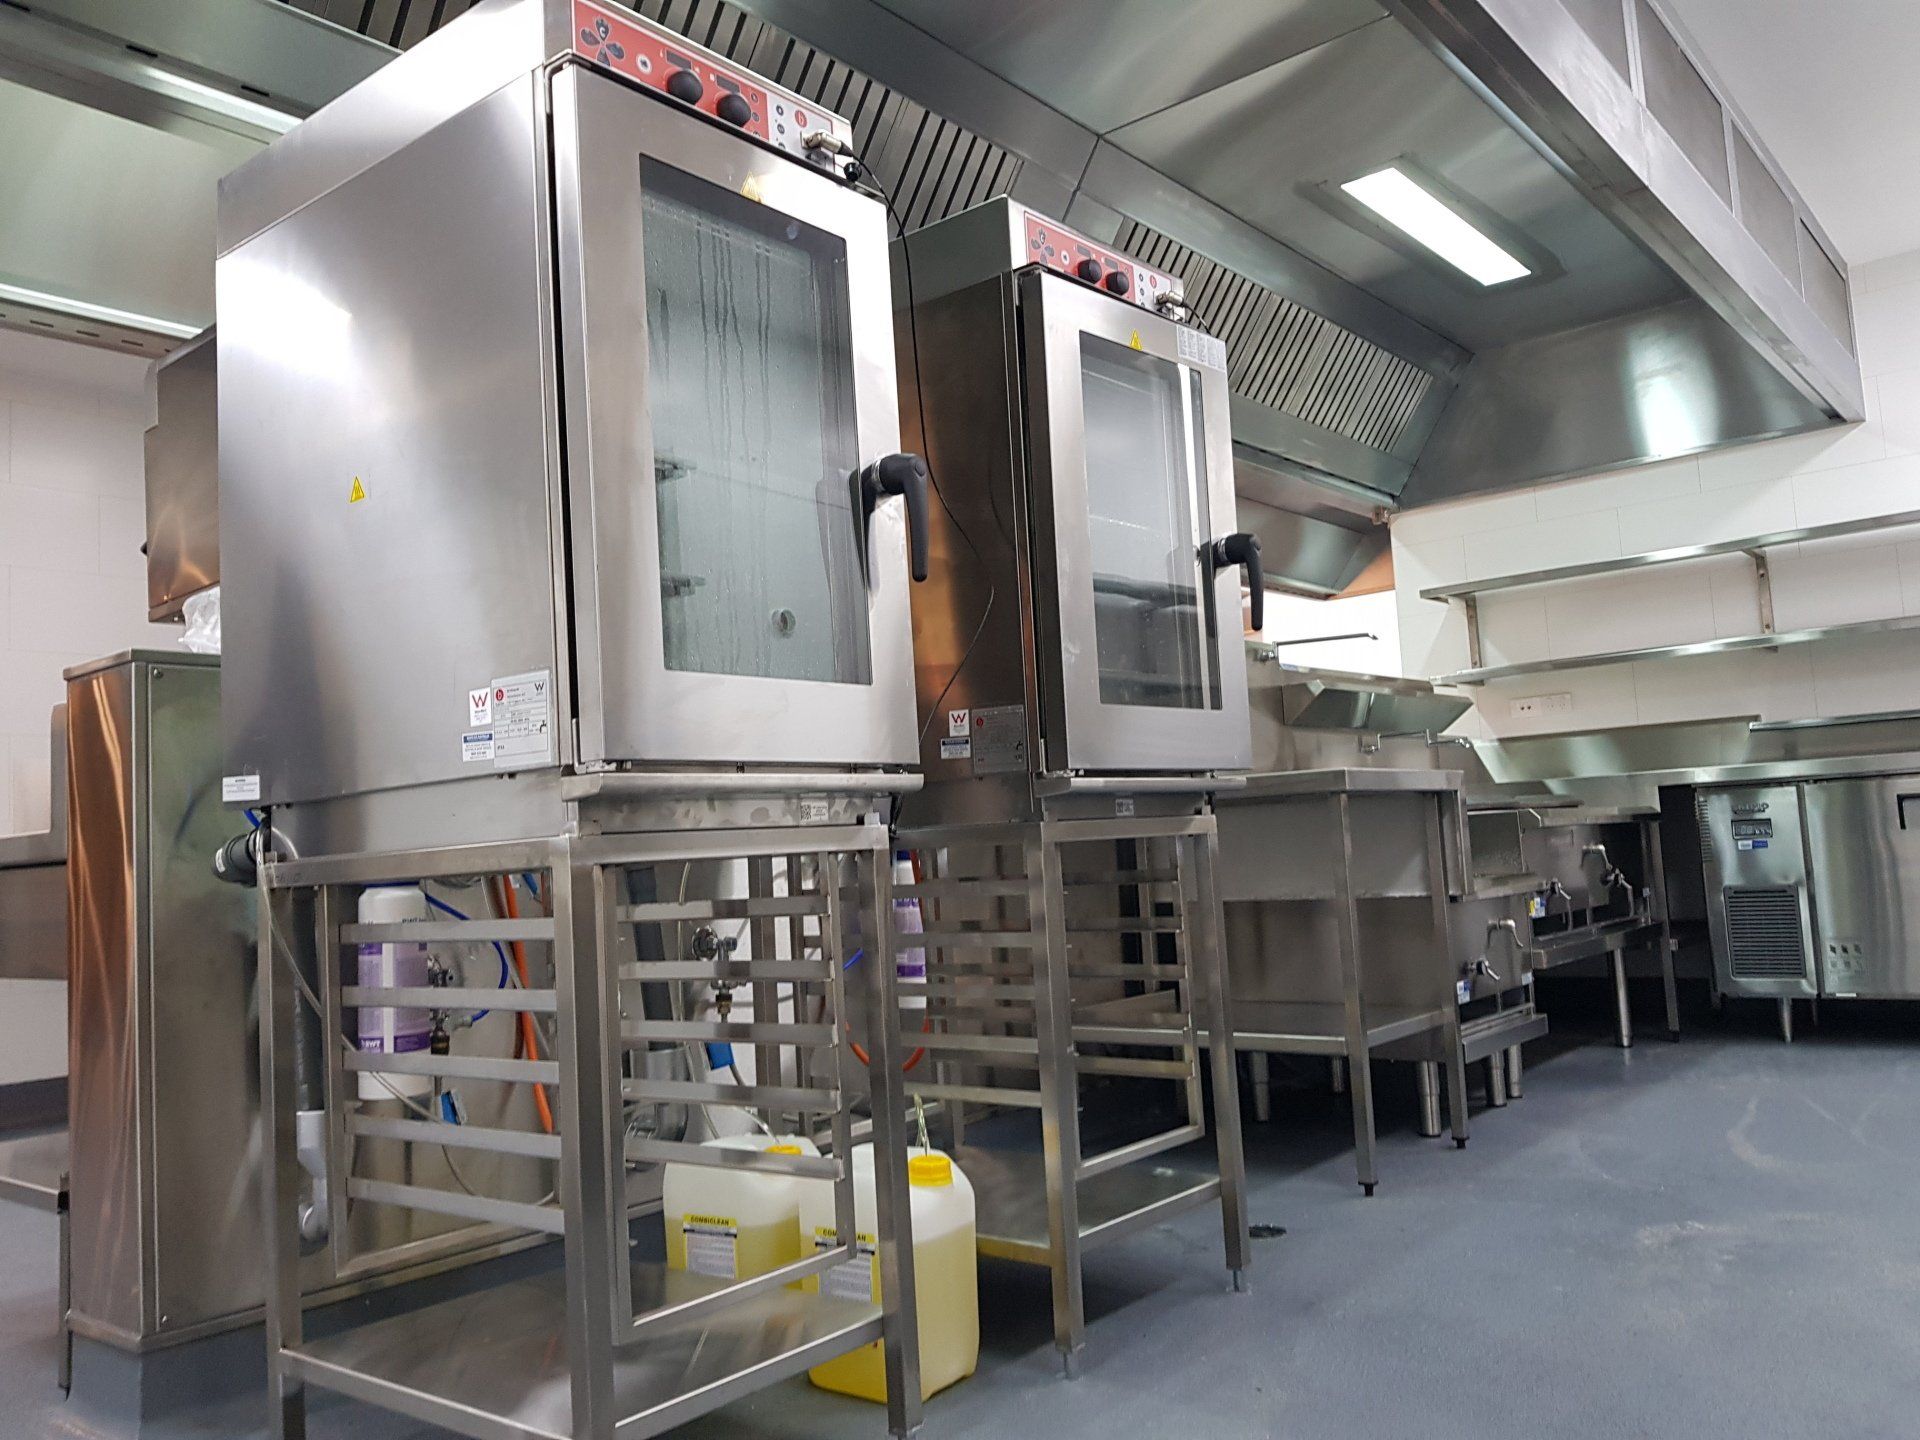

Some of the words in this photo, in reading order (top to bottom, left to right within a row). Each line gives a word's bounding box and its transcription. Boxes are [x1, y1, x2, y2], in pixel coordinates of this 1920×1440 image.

[472, 692, 488, 708] W
[951, 712, 966, 723] W
[690, 1215, 730, 1227] COMBICLEAN
